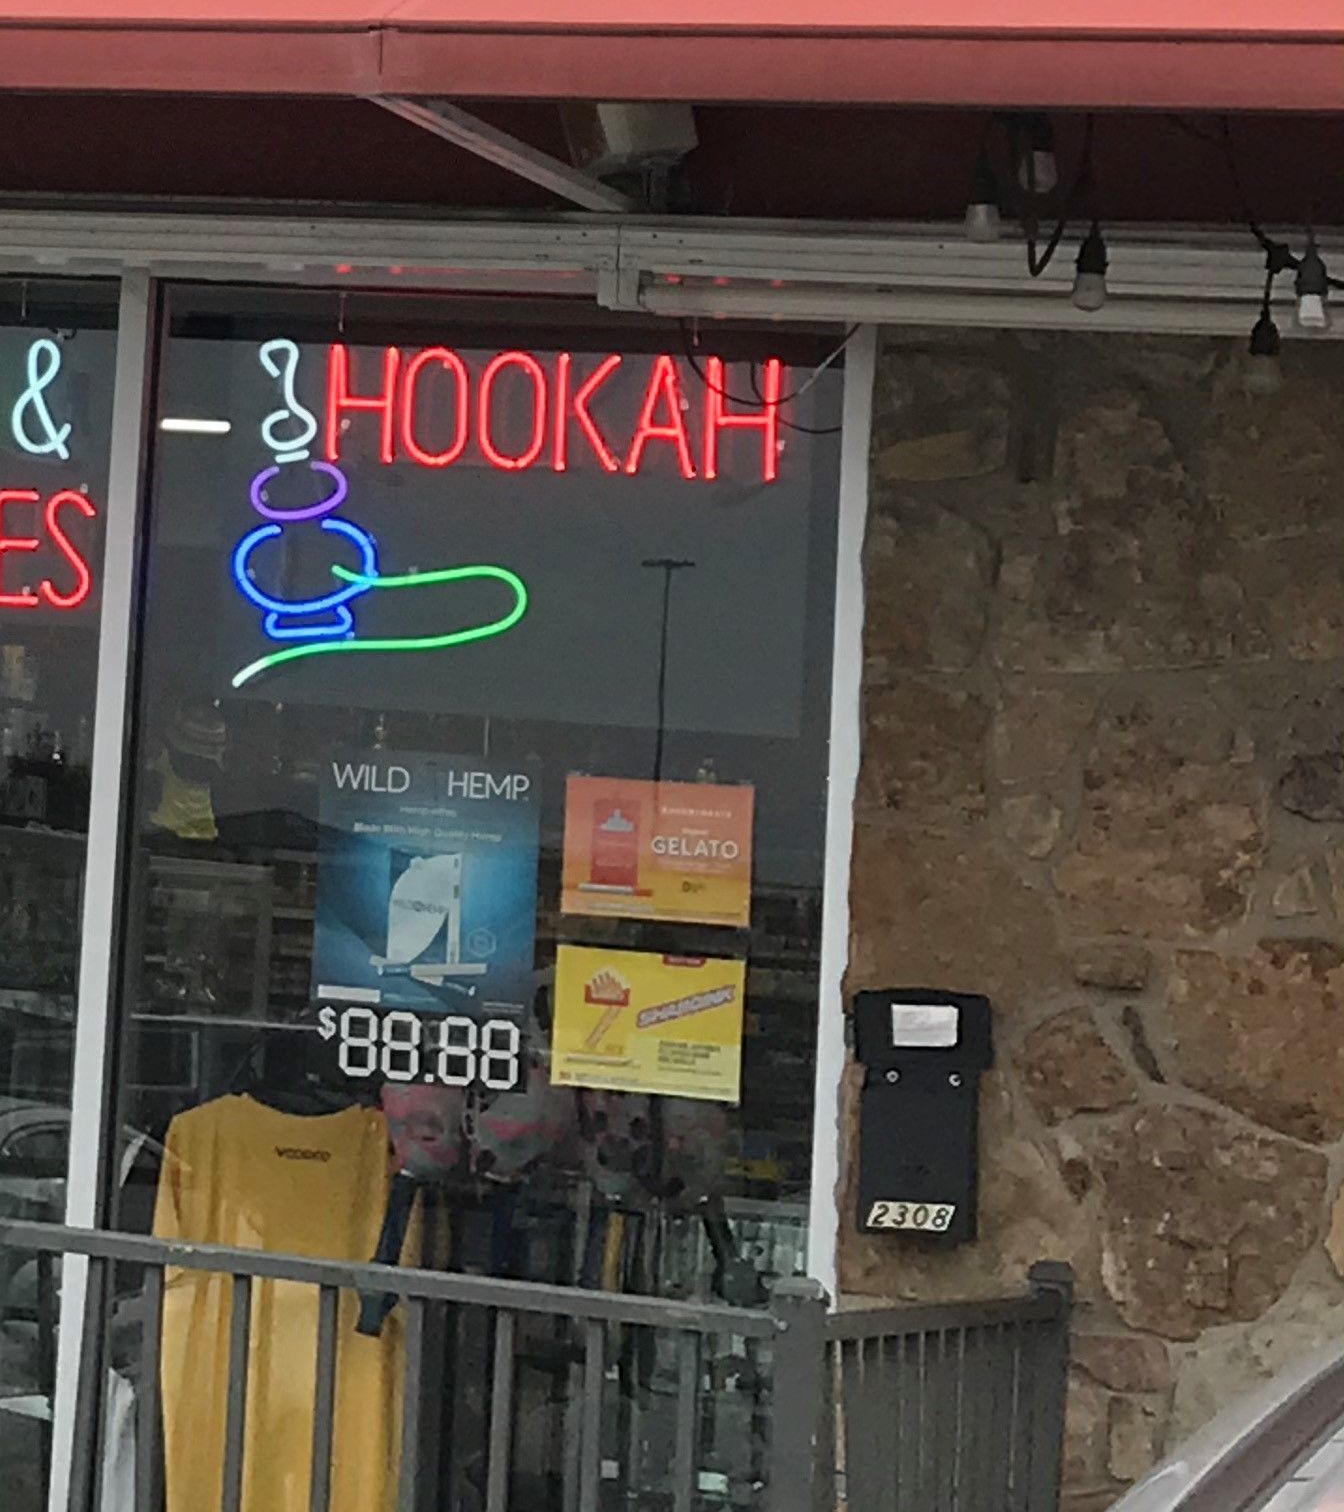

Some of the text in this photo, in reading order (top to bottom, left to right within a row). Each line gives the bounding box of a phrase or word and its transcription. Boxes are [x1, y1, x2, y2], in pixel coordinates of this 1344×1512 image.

[12, 339, 72, 459] &
[325, 343, 782, 481] HOOKAH
[332, 762, 530, 800] WILD HEMP
[651, 835, 739, 859] GELATO
[871, 1203, 951, 1229] 2308
